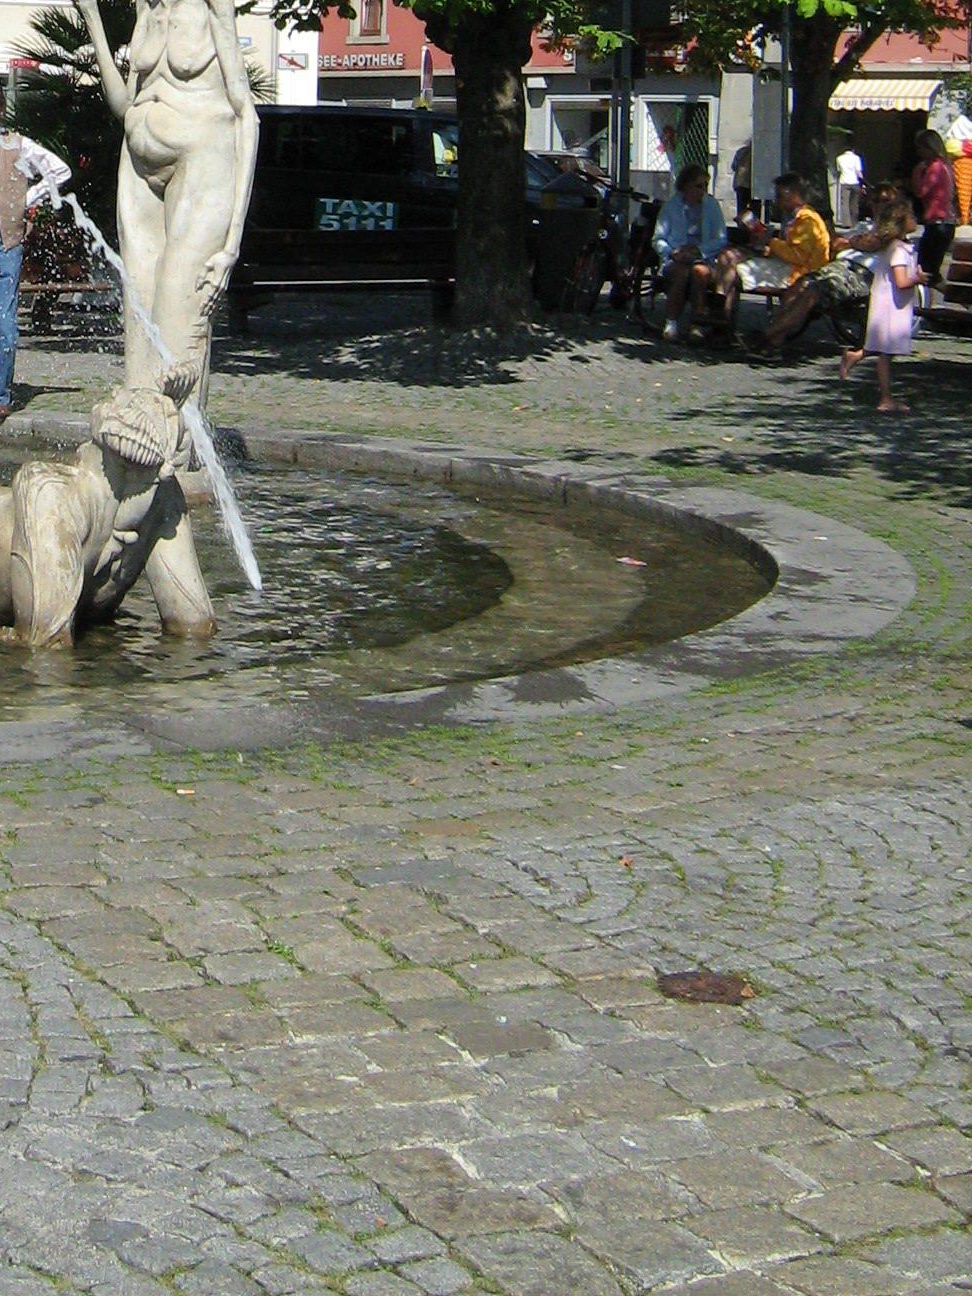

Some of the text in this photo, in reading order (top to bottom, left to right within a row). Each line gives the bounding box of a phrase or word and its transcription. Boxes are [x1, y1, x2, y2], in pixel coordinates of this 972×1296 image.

[318, 53, 403, 68] SEE-APOTHEKE
[318, 198, 395, 216] TAXI
[318, 214, 395, 231] 5111
